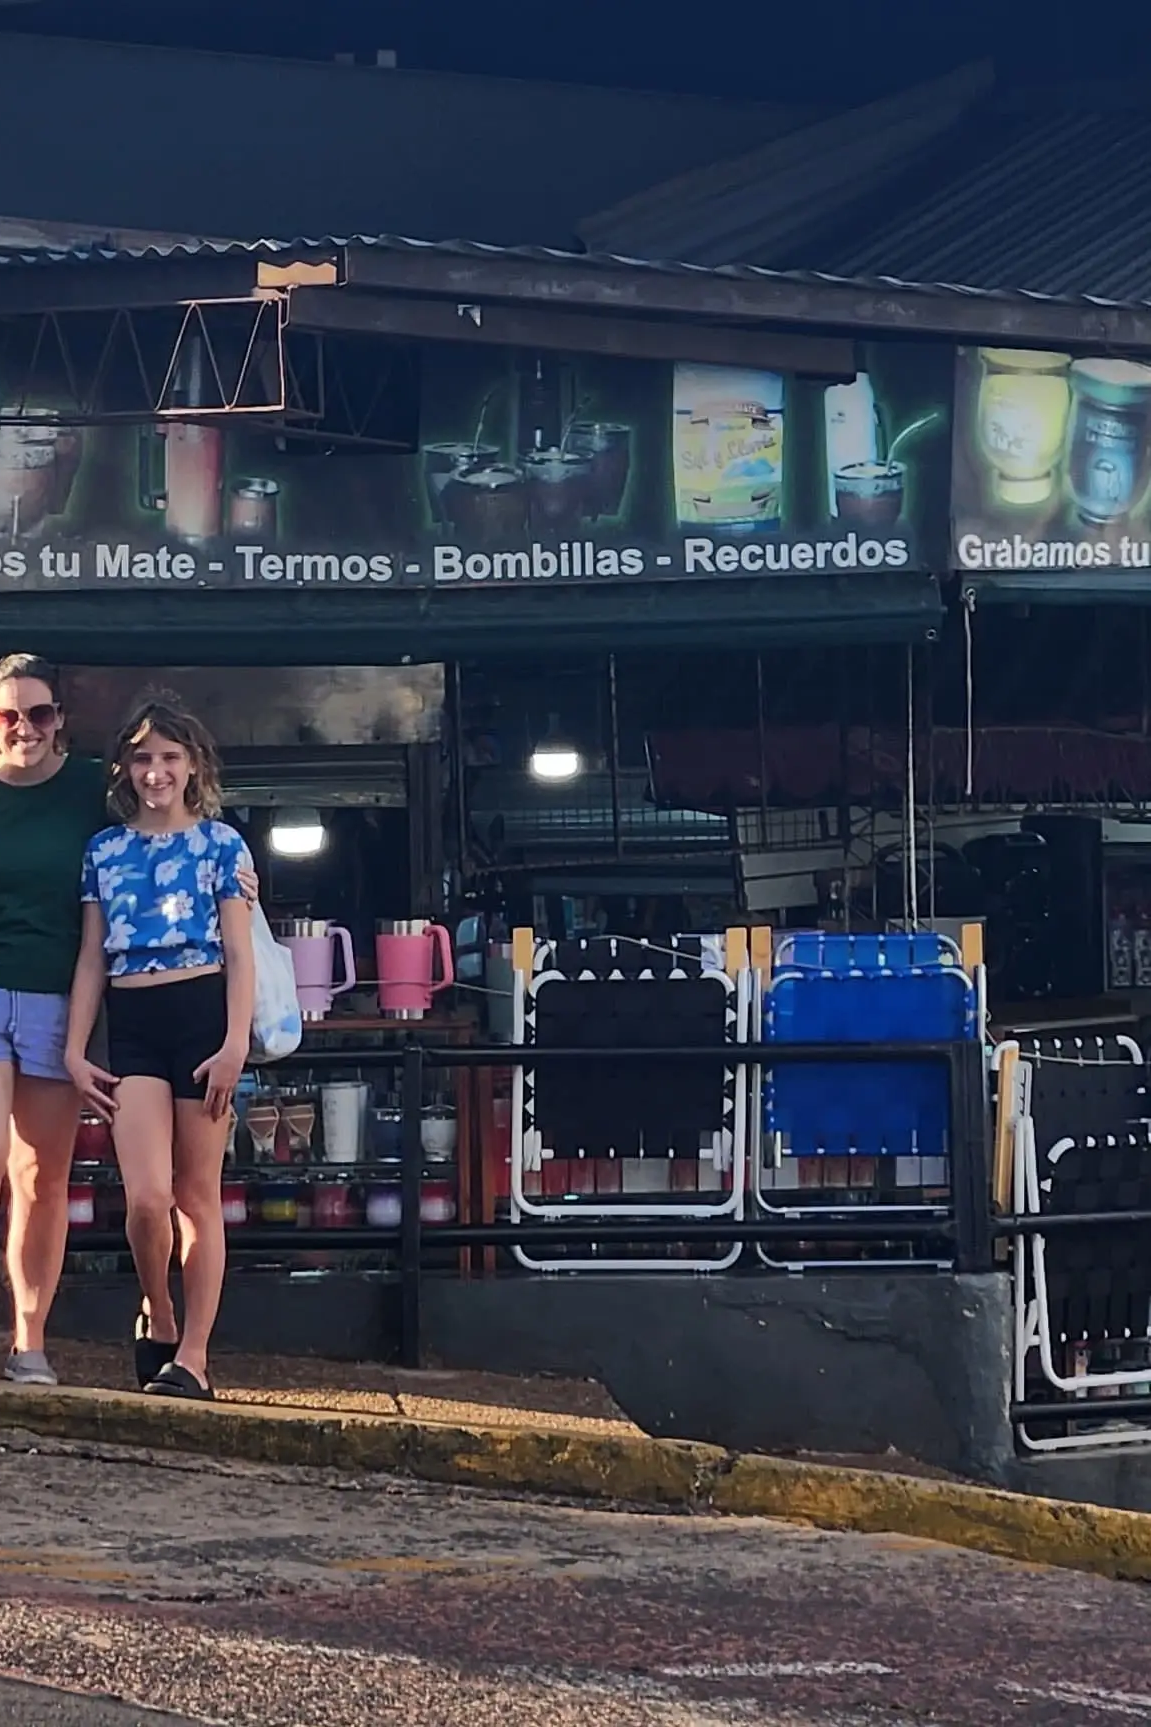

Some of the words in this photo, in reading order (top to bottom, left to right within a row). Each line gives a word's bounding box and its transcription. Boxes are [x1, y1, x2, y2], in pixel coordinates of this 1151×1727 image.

[39, 544, 81, 578] tu
[96, 544, 196, 579] Mate
[235, 545, 393, 582] Termos
[434, 541, 645, 580] Bombillas
[684, 532, 909, 573] Recuerdos
[958, 534, 1112, 568] Grabamos
[1119, 535, 1151, 568] tu
